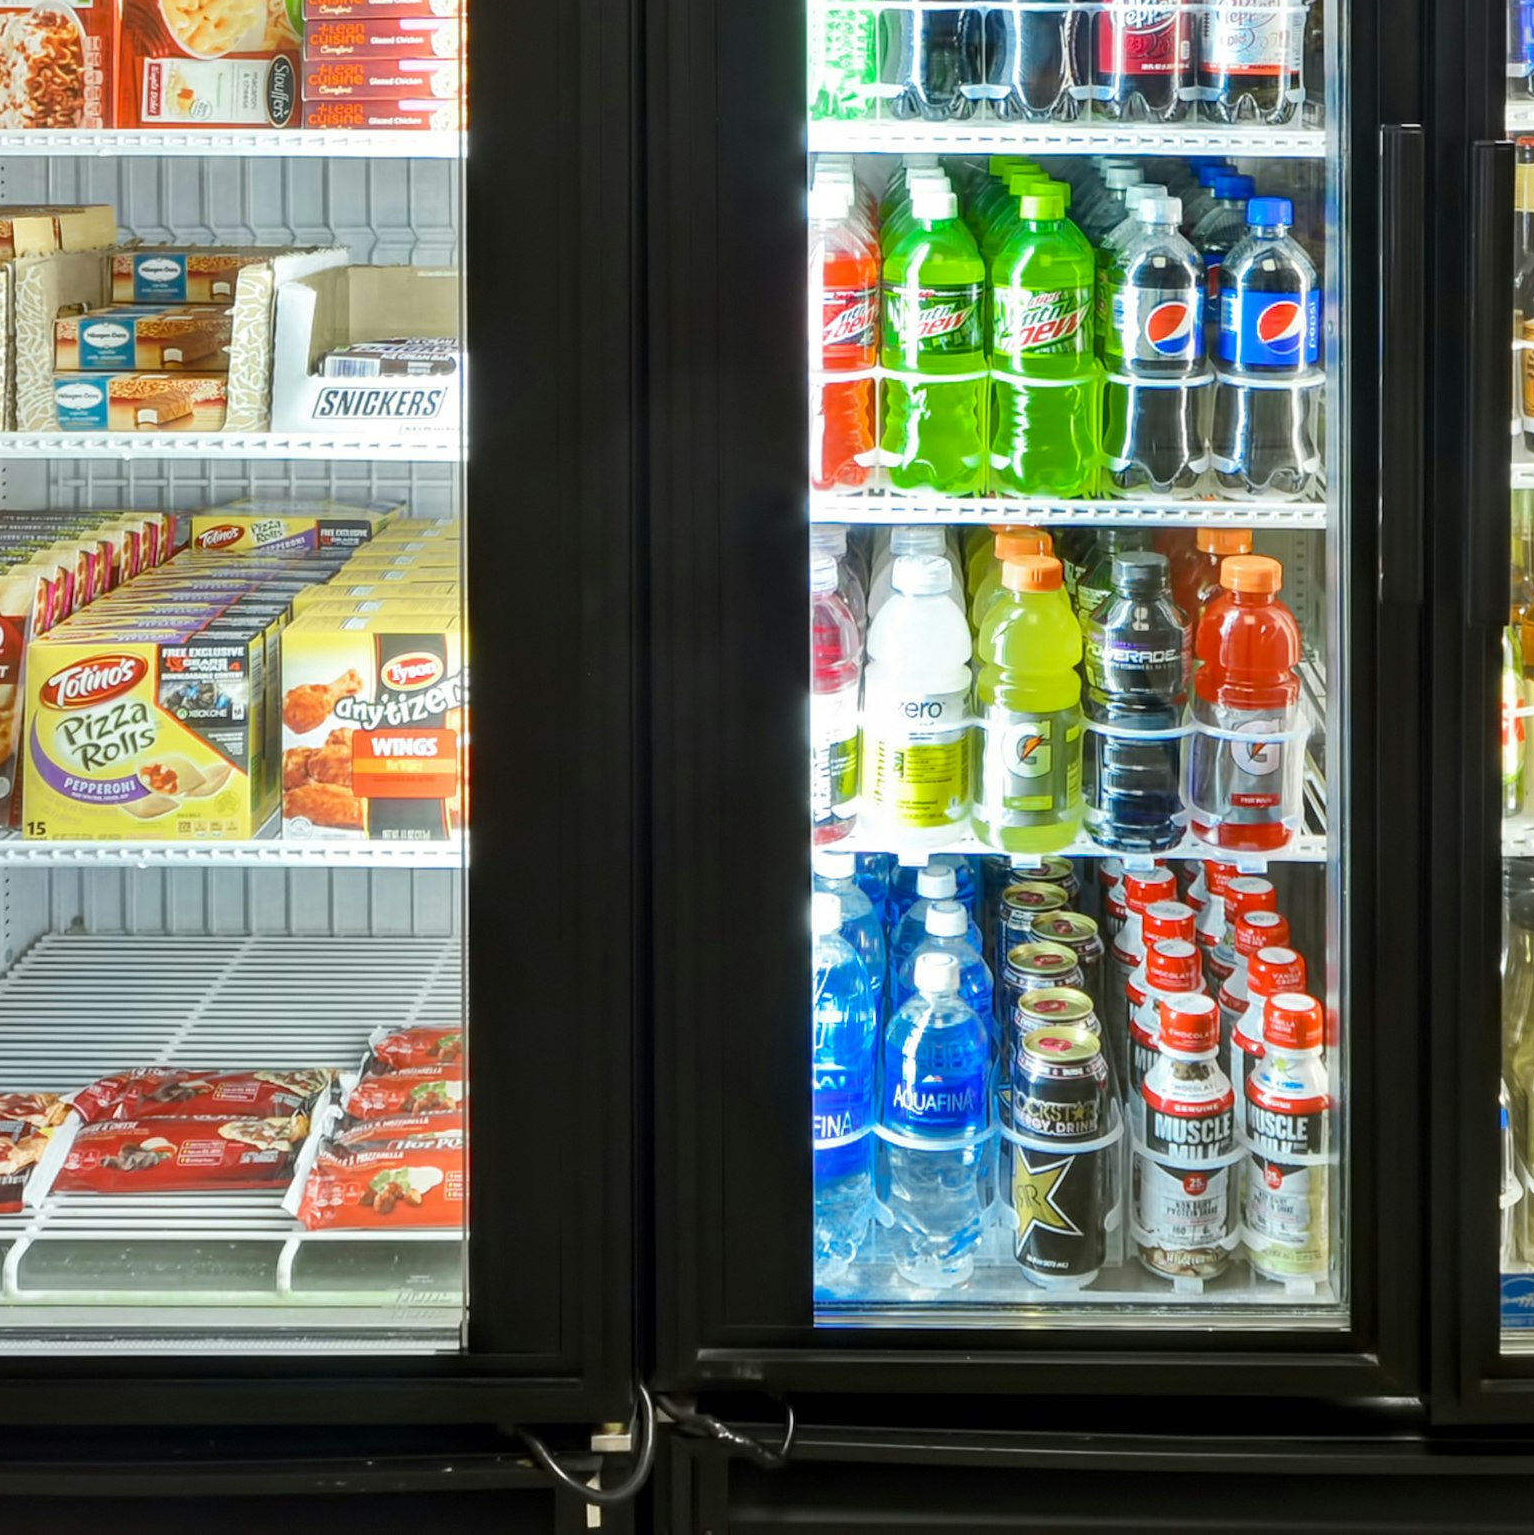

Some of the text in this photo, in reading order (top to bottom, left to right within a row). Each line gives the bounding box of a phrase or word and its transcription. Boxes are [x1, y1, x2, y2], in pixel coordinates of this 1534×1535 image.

[310, 33, 365, 45] cuisine
[308, 73, 363, 85] cuisine
[271, 63, 289, 119] Stouffer's
[308, 113, 363, 125] cuisine
[1308, 302, 1317, 348] pepsi
[319, 390, 442, 416] SNICKERS
[199, 526, 241, 548] Totino's
[251, 520, 281, 535] Pizza
[255, 526, 283, 545] Rolls
[162, 646, 244, 658] FREE EXCLUSIVE
[1087, 646, 1178, 664] OWERADE
[182, 658, 228, 667] GEARS
[49, 657, 136, 707] Totino's
[391, 661, 437, 685] Tyson
[898, 700, 943, 719] ero
[56, 702, 148, 746] Pizza
[72, 728, 156, 772] Rolls
[371, 737, 438, 757] WINGS
[64, 777, 136, 796] PEPPERONI
[26, 821, 46, 835] 15
[893, 1083, 974, 1115] AQUAFINA
[1174, 1104, 1219, 1113] GENUINE
[1155, 1113, 1231, 1144] MUSCLE
[1169, 1143, 1221, 1161] MILK
